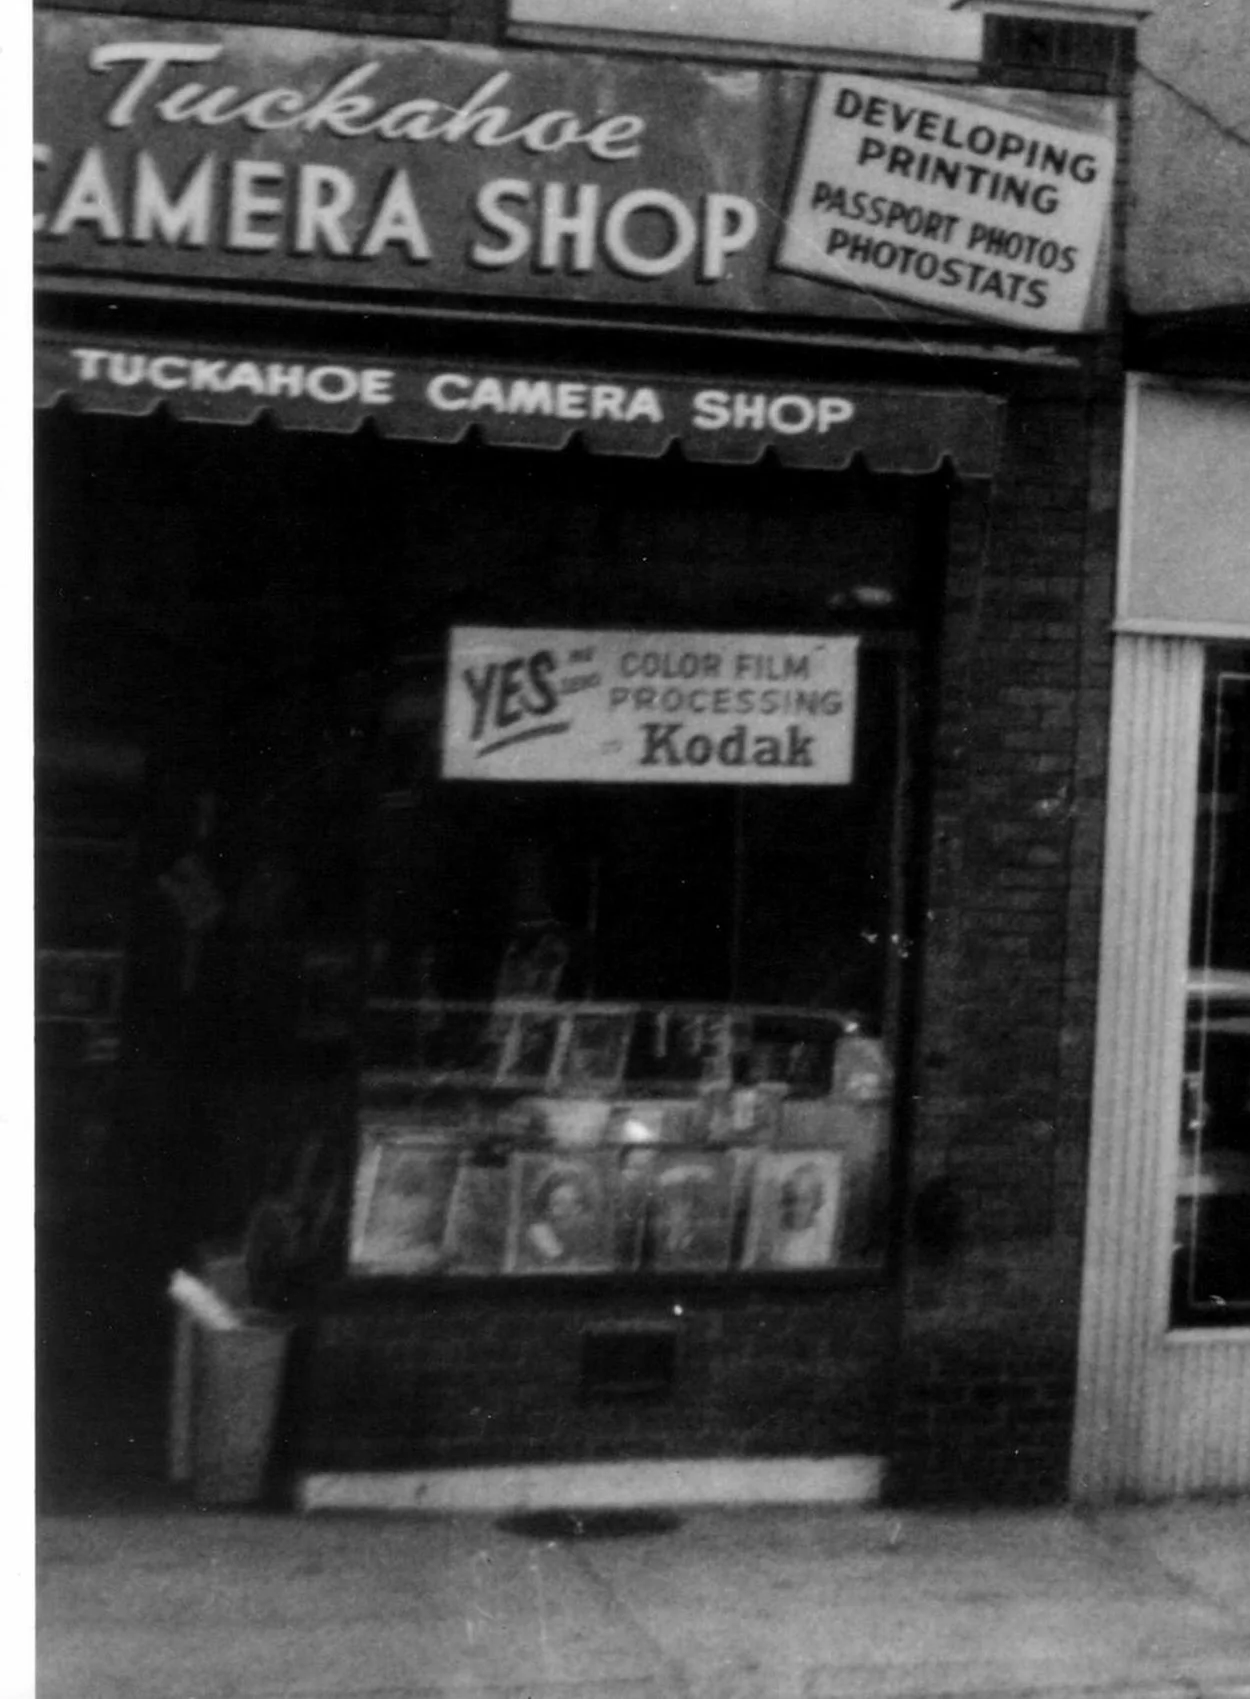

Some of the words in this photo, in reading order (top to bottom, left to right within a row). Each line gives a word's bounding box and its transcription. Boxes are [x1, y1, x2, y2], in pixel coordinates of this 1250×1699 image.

[90, 42, 646, 159] Tuckahoe
[833, 88, 1097, 185] DEVELOPING
[858, 137, 1058, 216] PRINTING
[473, 178, 758, 280] SHOP
[811, 180, 961, 245] PASSPORT
[967, 220, 1077, 275] PHOTOS
[826, 227, 1049, 310] PHOTOSTATS
[71, 348, 394, 405] TUCKAHOE
[426, 373, 663, 423] CAMERA
[692, 390, 855, 435] SHOP
[462, 649, 559, 742] YES
[608, 686, 844, 716] PROCESSING
[619, 650, 722, 680] COLOR
[735, 653, 811, 682] FILM
[639, 722, 816, 767] Kodak
